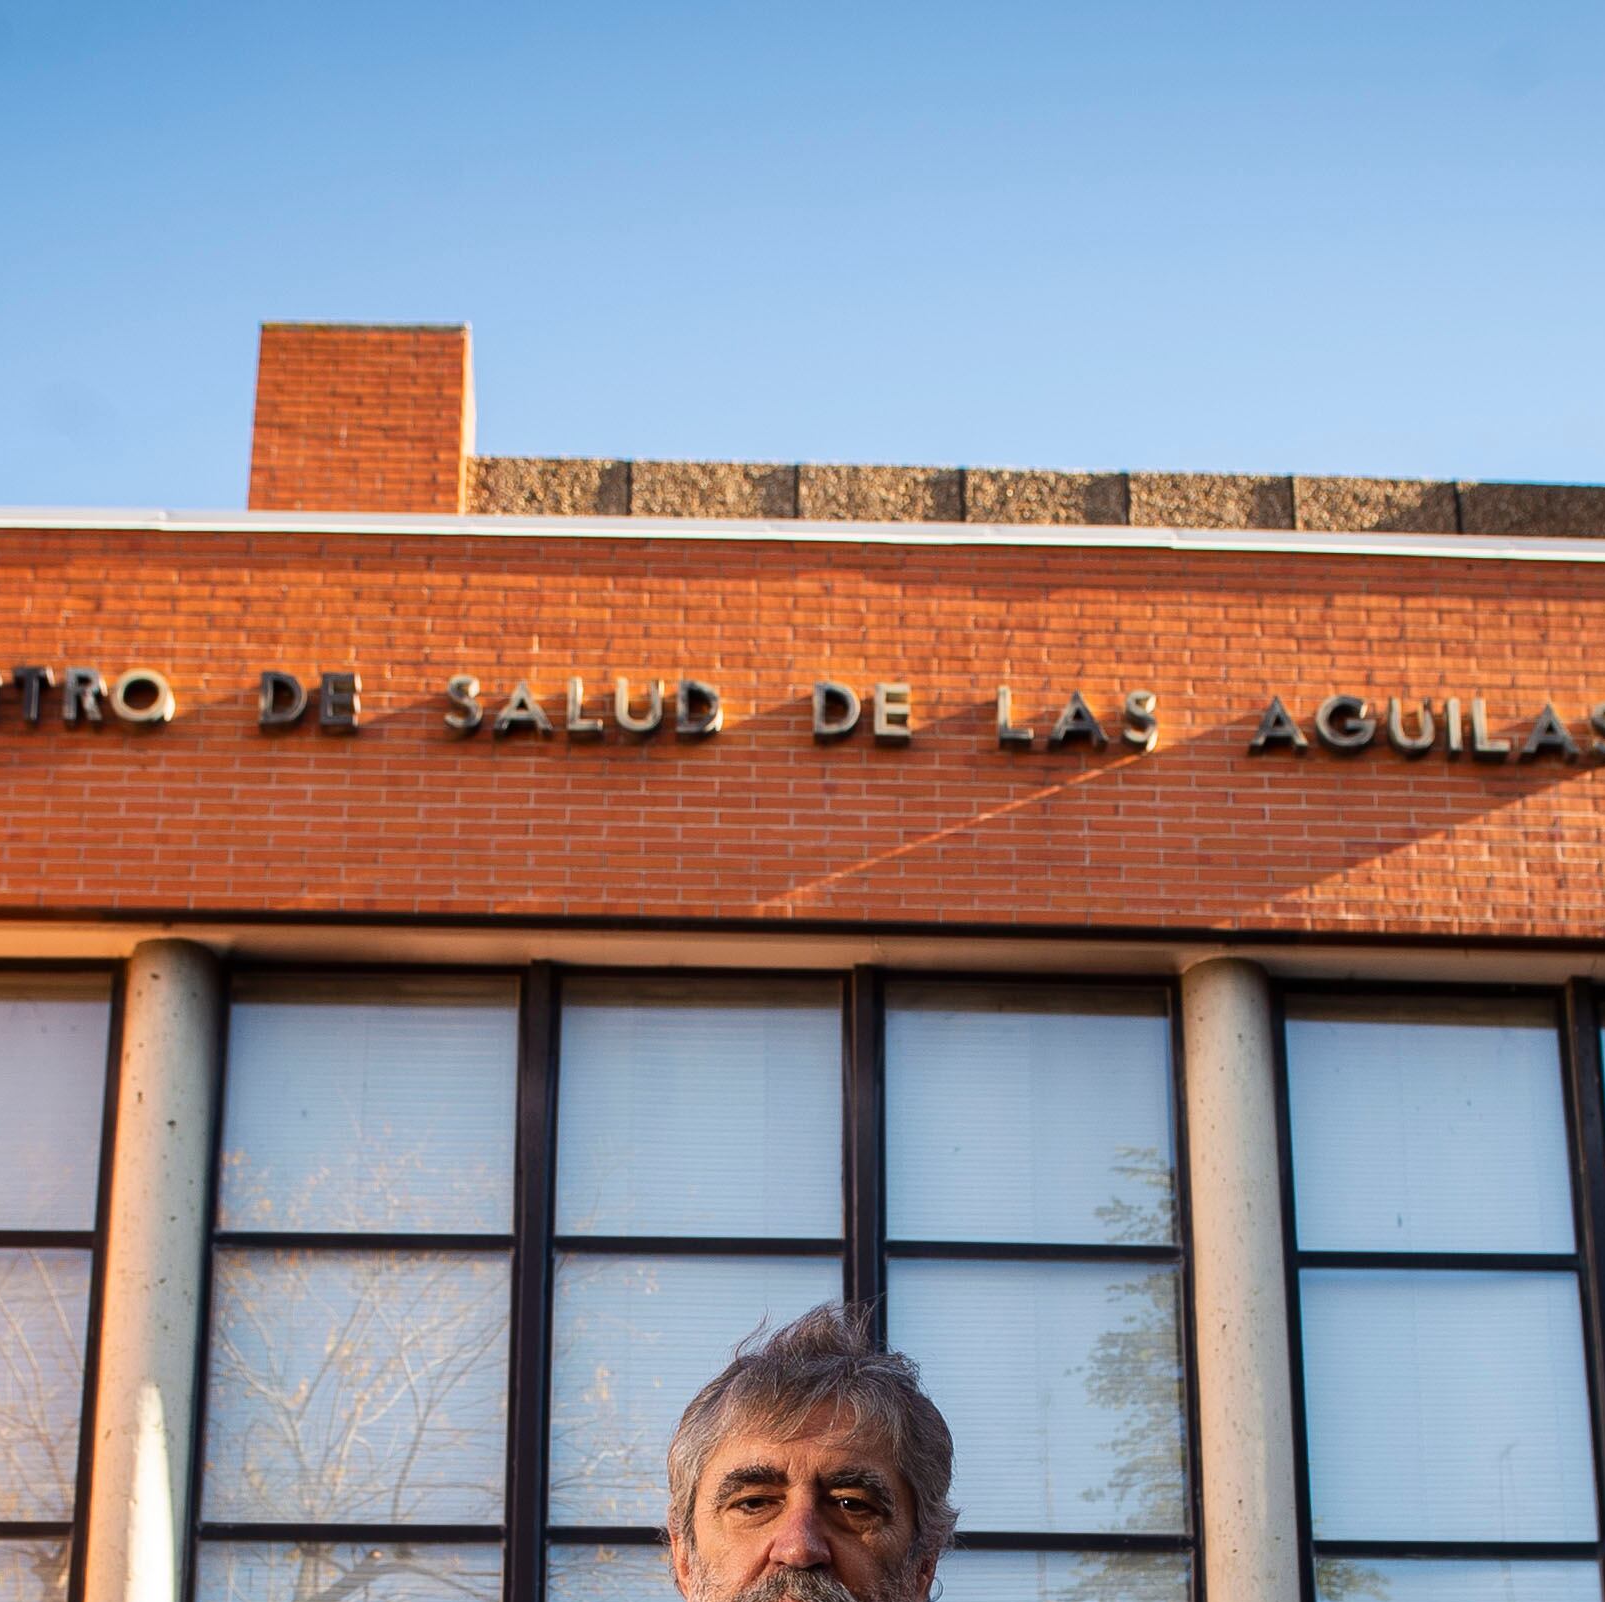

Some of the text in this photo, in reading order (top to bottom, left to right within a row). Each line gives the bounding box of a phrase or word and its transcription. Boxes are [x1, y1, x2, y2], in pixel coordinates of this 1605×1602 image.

[257, 670, 364, 734] DE
[443, 674, 725, 740] SALUD
[811, 681, 915, 744] DE
[995, 684, 1159, 752] LAS
